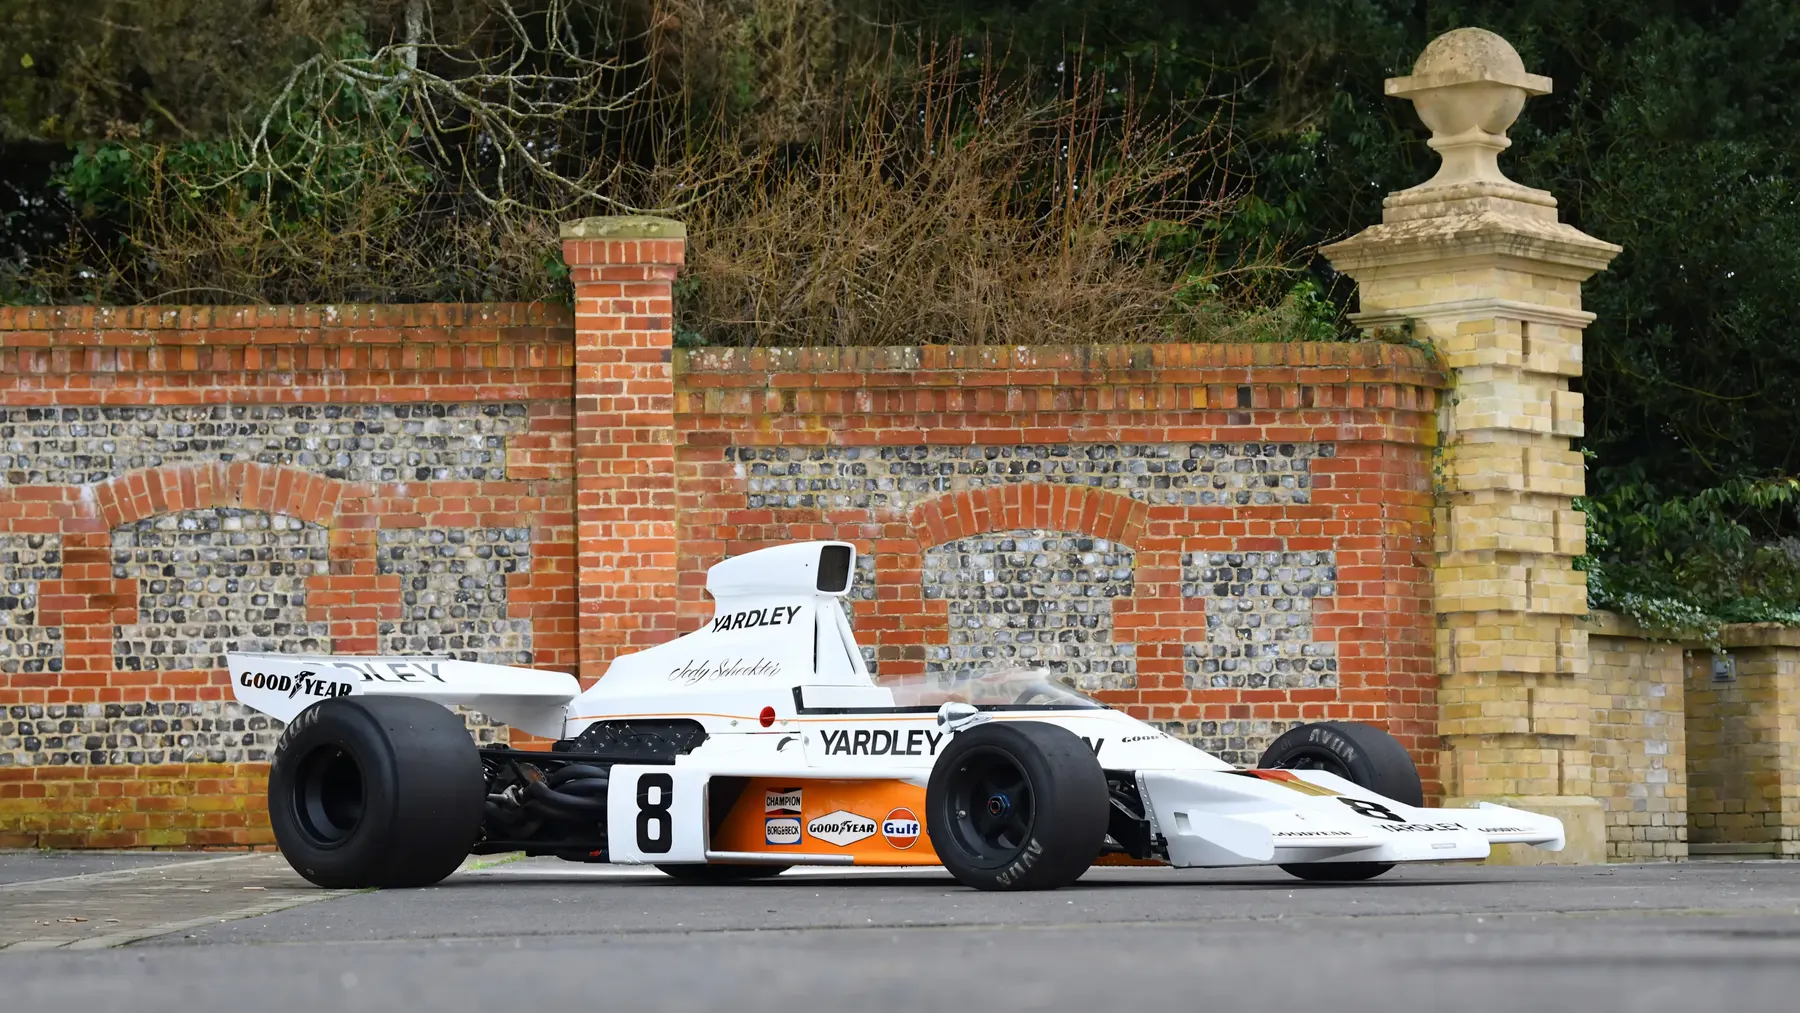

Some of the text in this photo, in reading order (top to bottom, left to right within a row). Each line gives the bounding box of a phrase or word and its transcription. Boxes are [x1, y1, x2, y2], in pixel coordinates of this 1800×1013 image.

[712, 606, 802, 633] YARDLEY
[302, 662, 446, 683] DLEY
[820, 730, 944, 756] YARDLEY
[766, 796, 801, 806] CHAMPION
[1336, 796, 1407, 823] 8
[637, 773, 674, 854] 8
[809, 820, 875, 835] GOODYEAR
[883, 822, 919, 835] Gulf
[1372, 822, 1468, 833] YARDLEY
